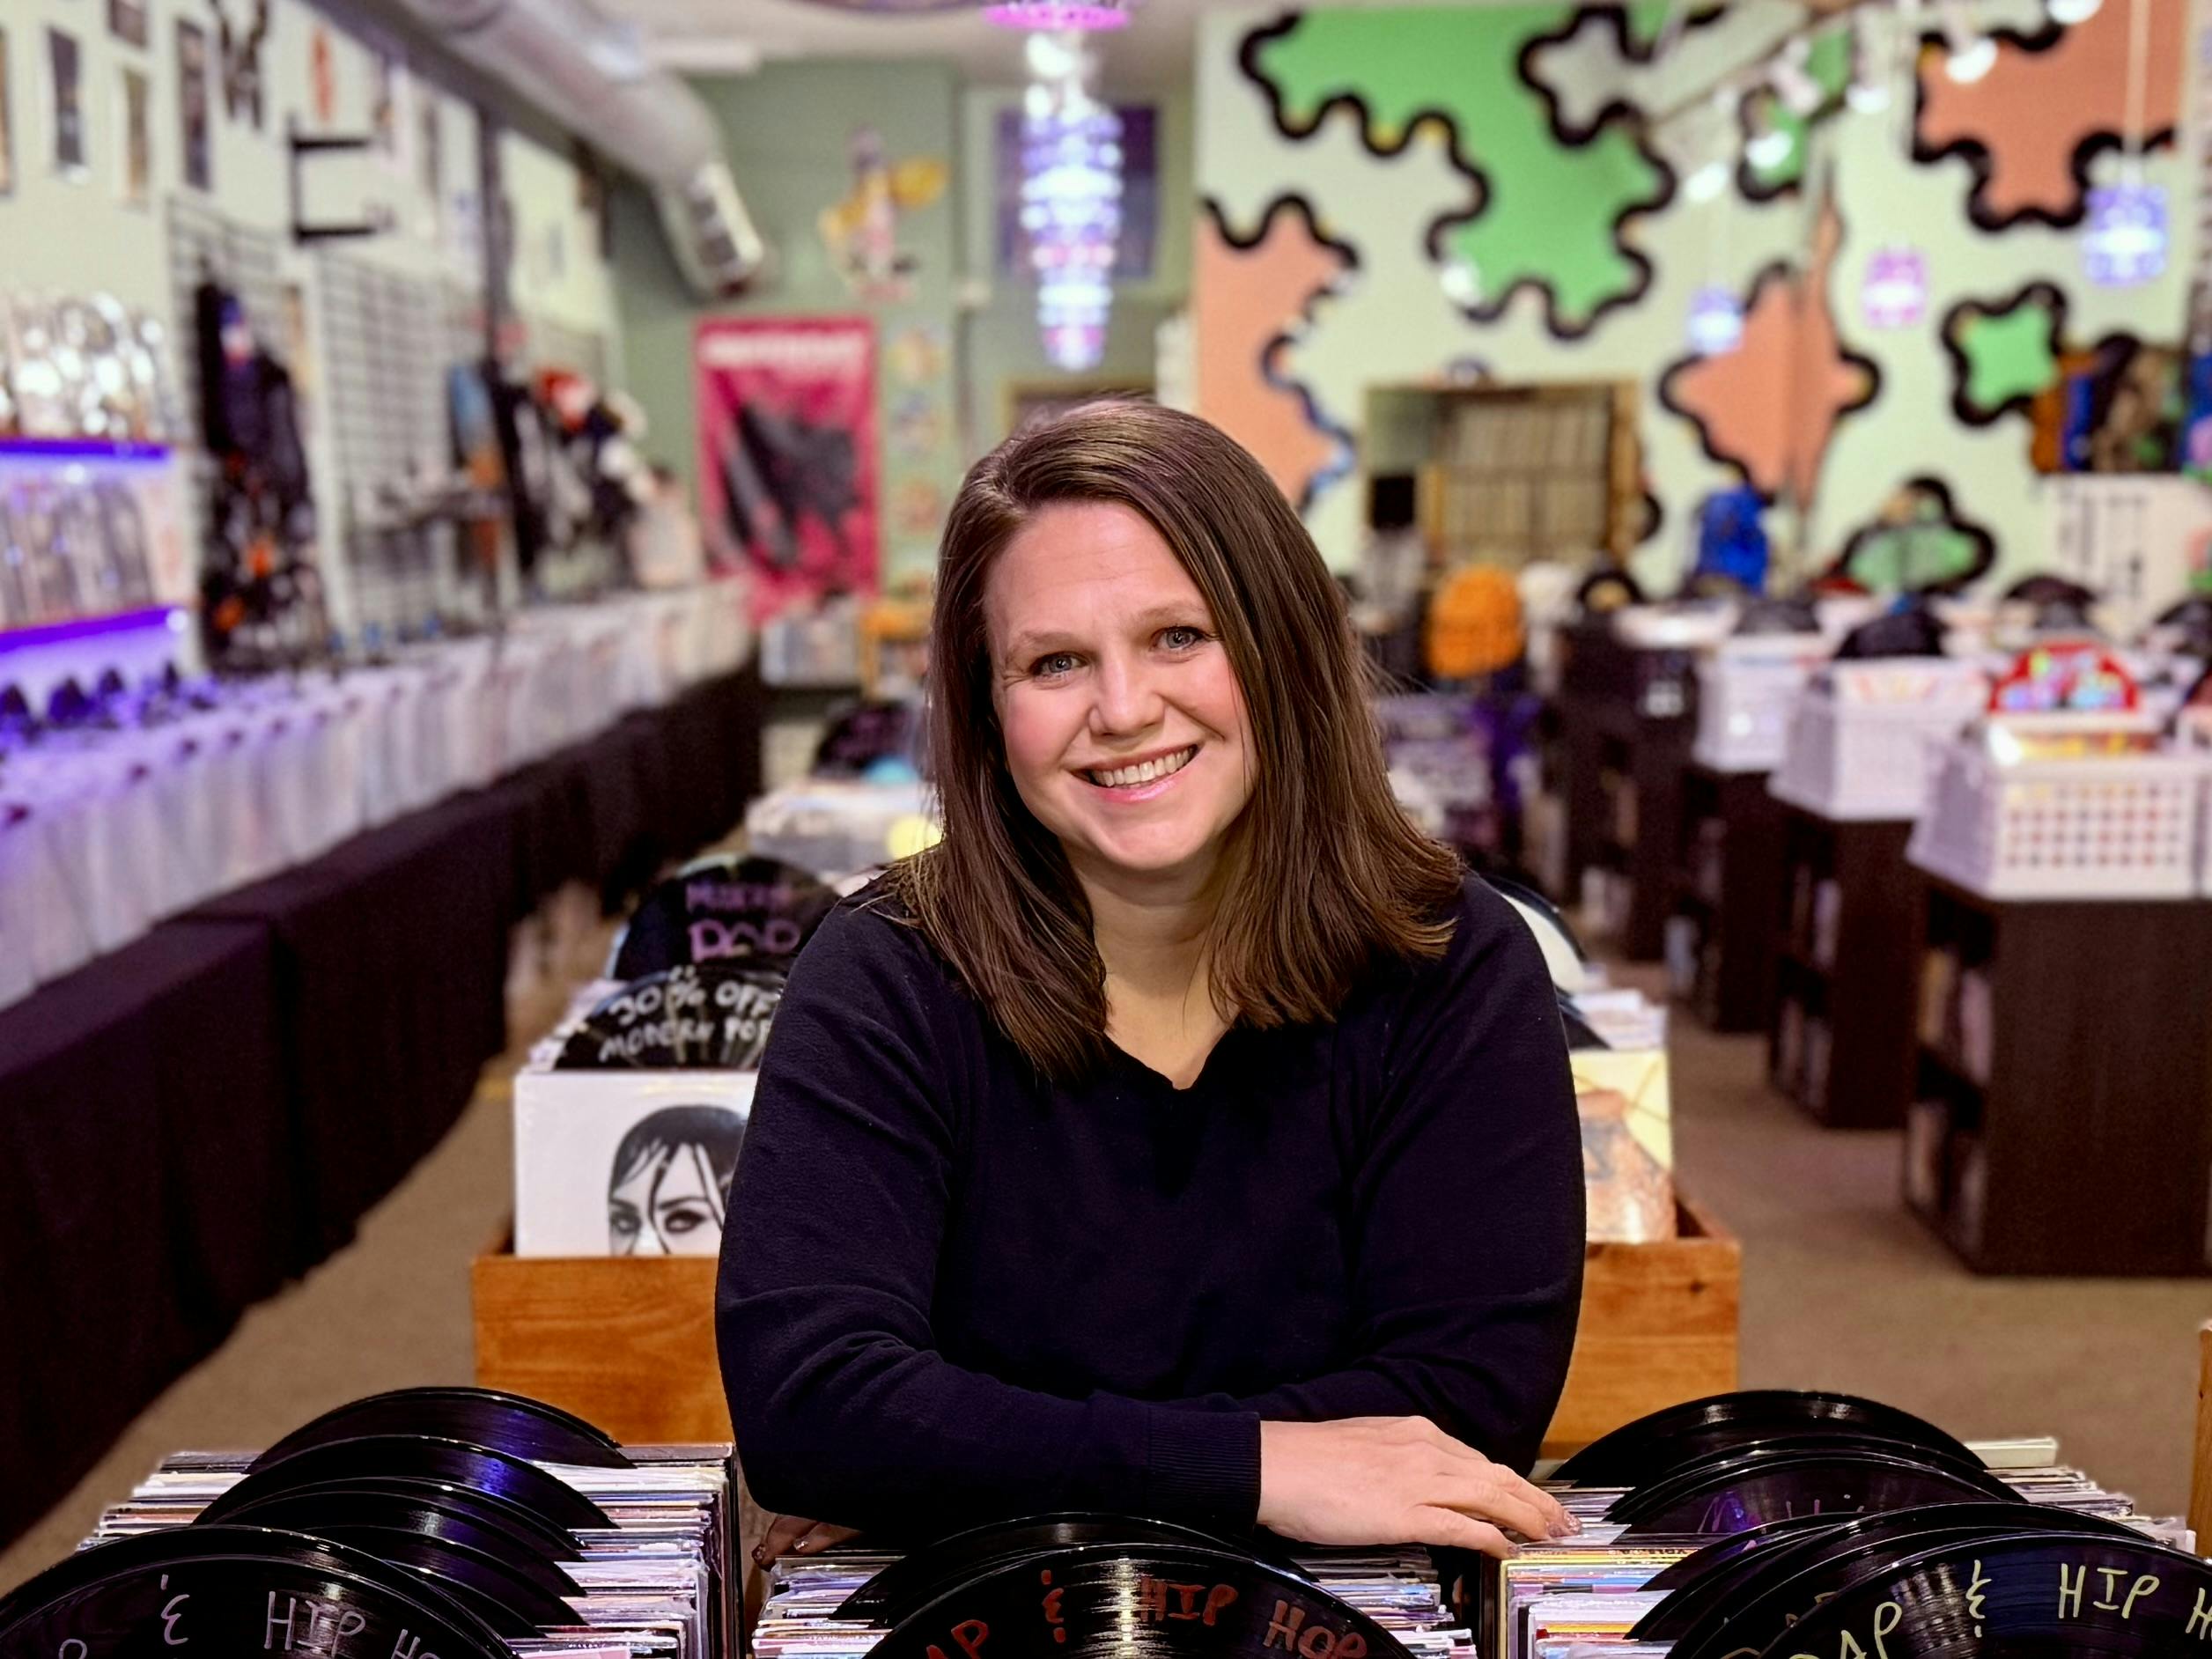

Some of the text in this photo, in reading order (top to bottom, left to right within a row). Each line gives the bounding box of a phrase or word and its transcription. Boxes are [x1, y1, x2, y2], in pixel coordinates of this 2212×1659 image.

[715, 979, 780, 1018] OFF
[598, 1015, 715, 1063] MODERN
[1140, 1576, 1238, 1626] HIP
[2058, 1563, 2160, 1619] HIP
[263, 1590, 367, 1659] HIP
